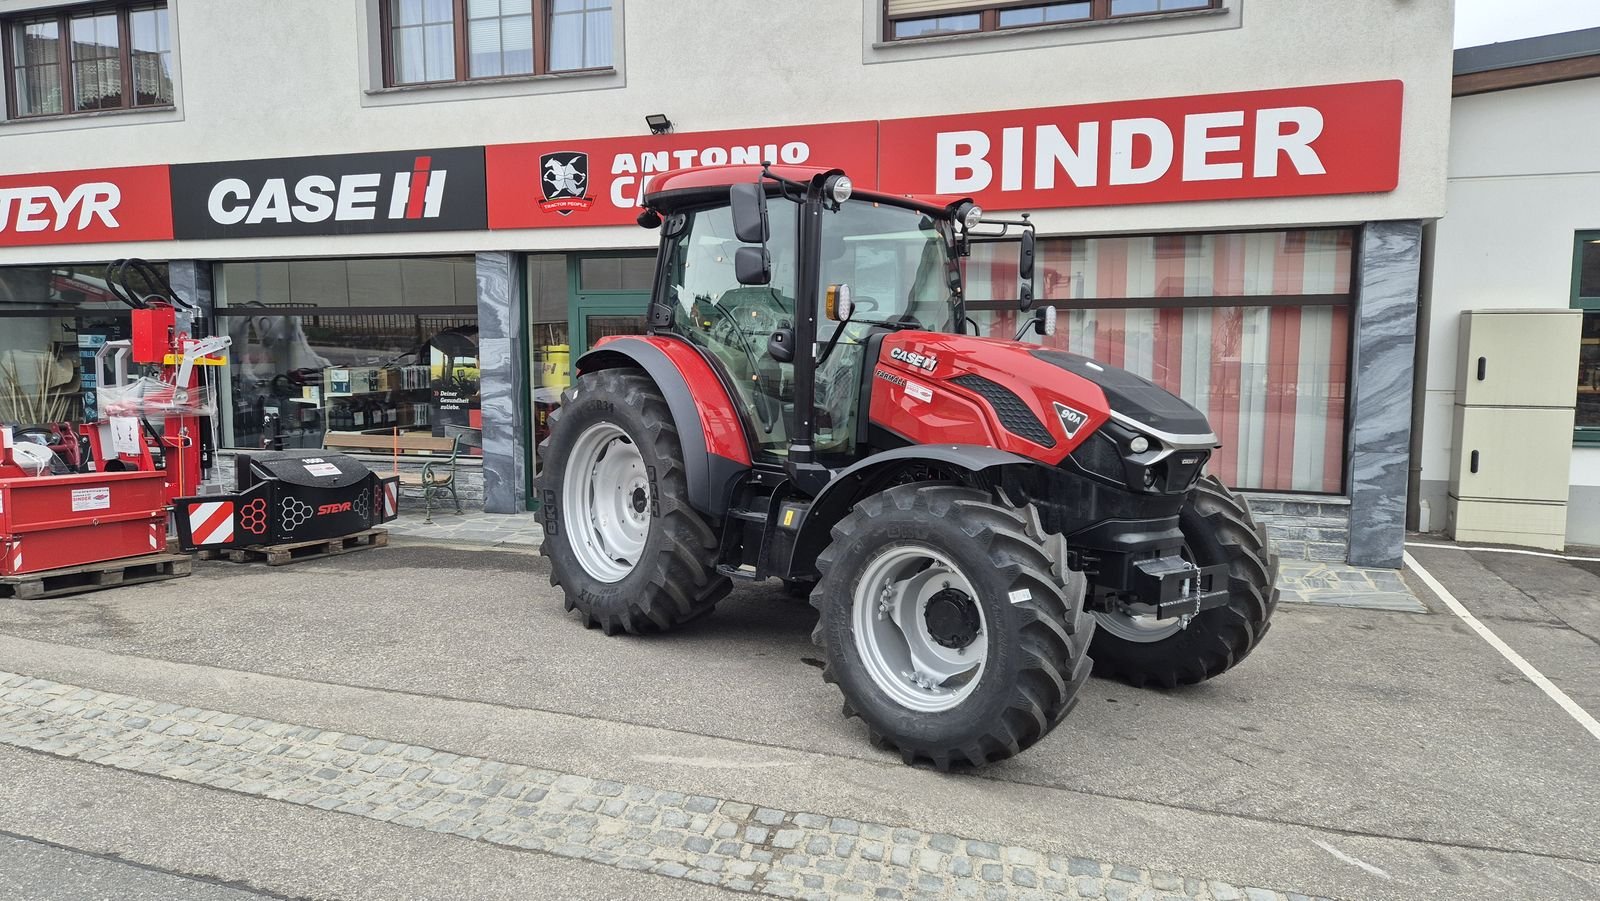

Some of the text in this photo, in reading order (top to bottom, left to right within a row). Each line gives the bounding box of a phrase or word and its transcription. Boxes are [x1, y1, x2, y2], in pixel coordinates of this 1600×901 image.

[611, 141, 810, 175] ANTONIO
[935, 106, 1326, 195] BINDER
[208, 156, 447, 225] CASE IH
[890, 347, 925, 367] CASE
[1060, 409, 1082, 425] 90A
[317, 501, 352, 516] STEYR
[543, 489, 559, 536] BKT
